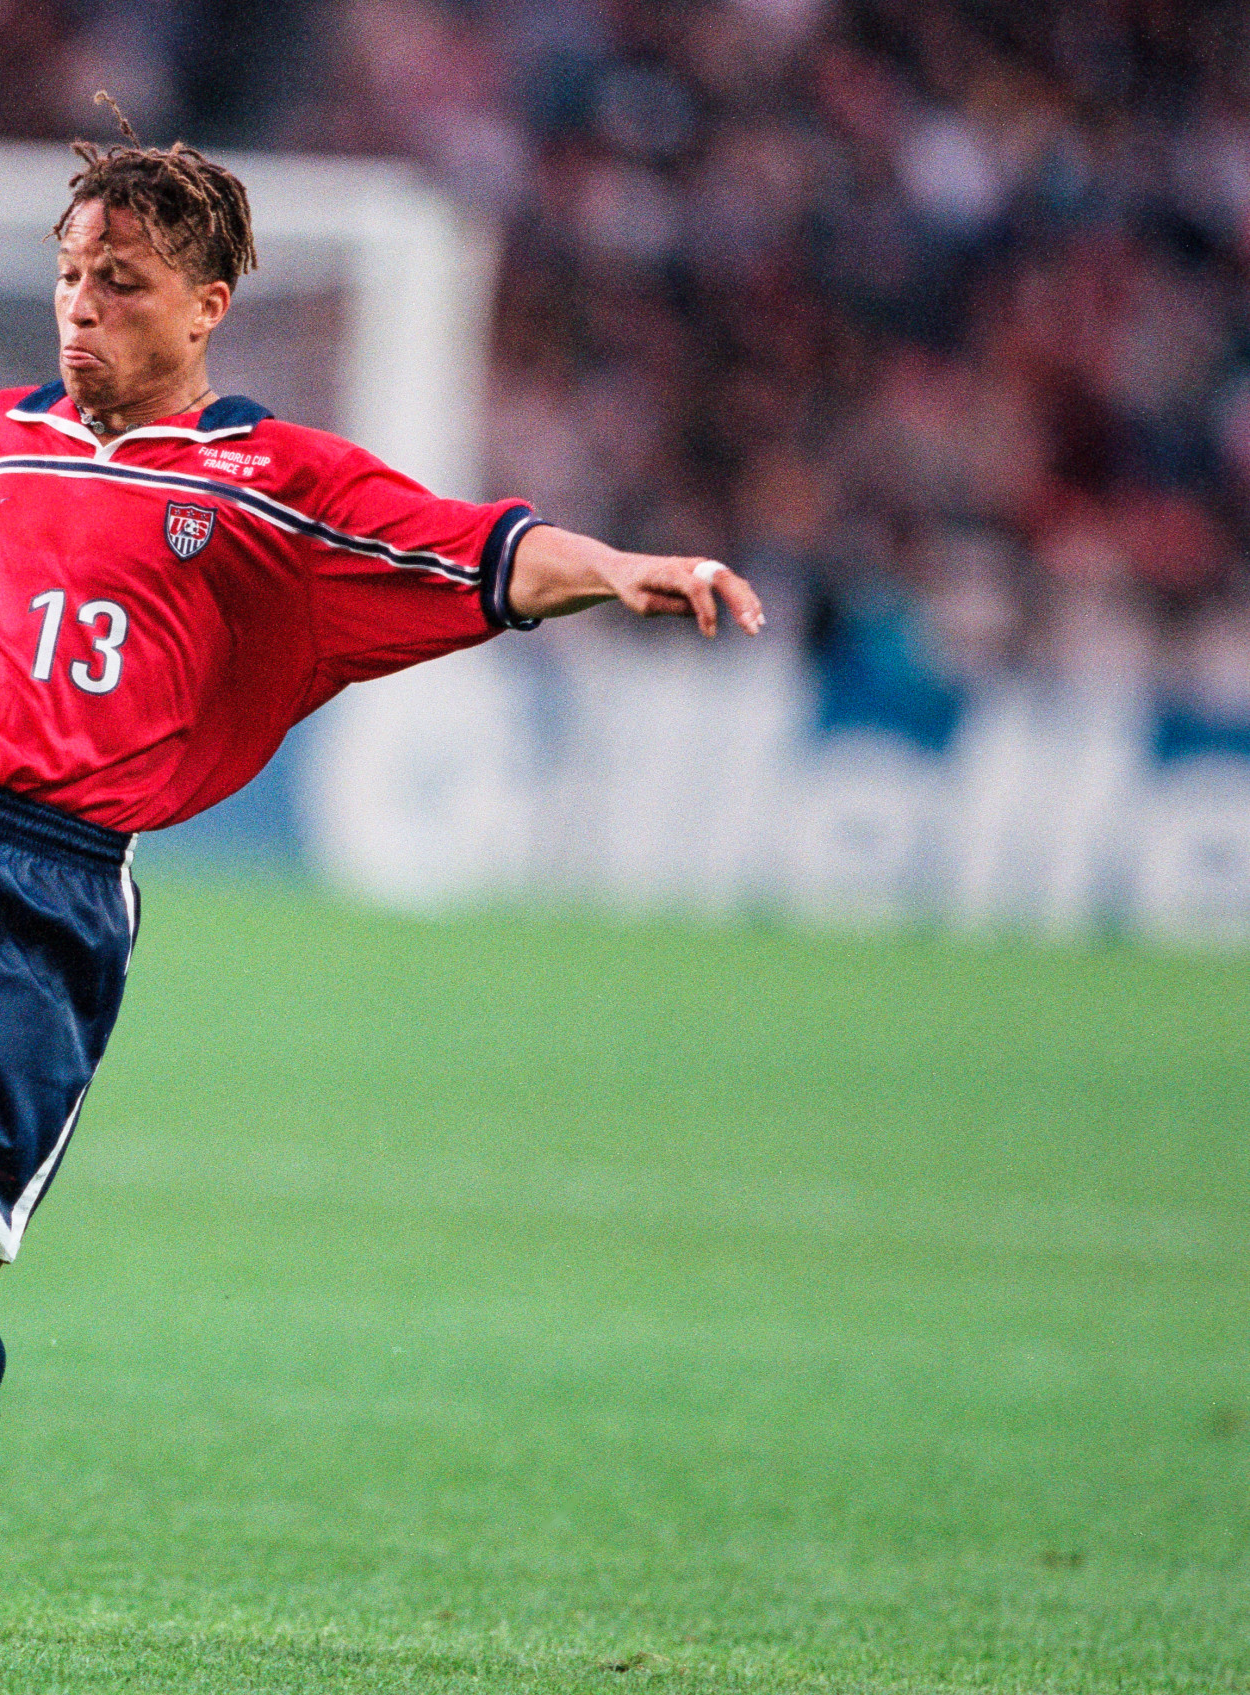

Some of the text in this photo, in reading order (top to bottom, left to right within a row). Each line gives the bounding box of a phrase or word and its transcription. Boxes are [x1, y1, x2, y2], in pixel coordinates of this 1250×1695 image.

[198, 446, 271, 467] FIFA WORLD CUP
[203, 458, 240, 475] FRANCE
[28, 588, 130, 696] 13
